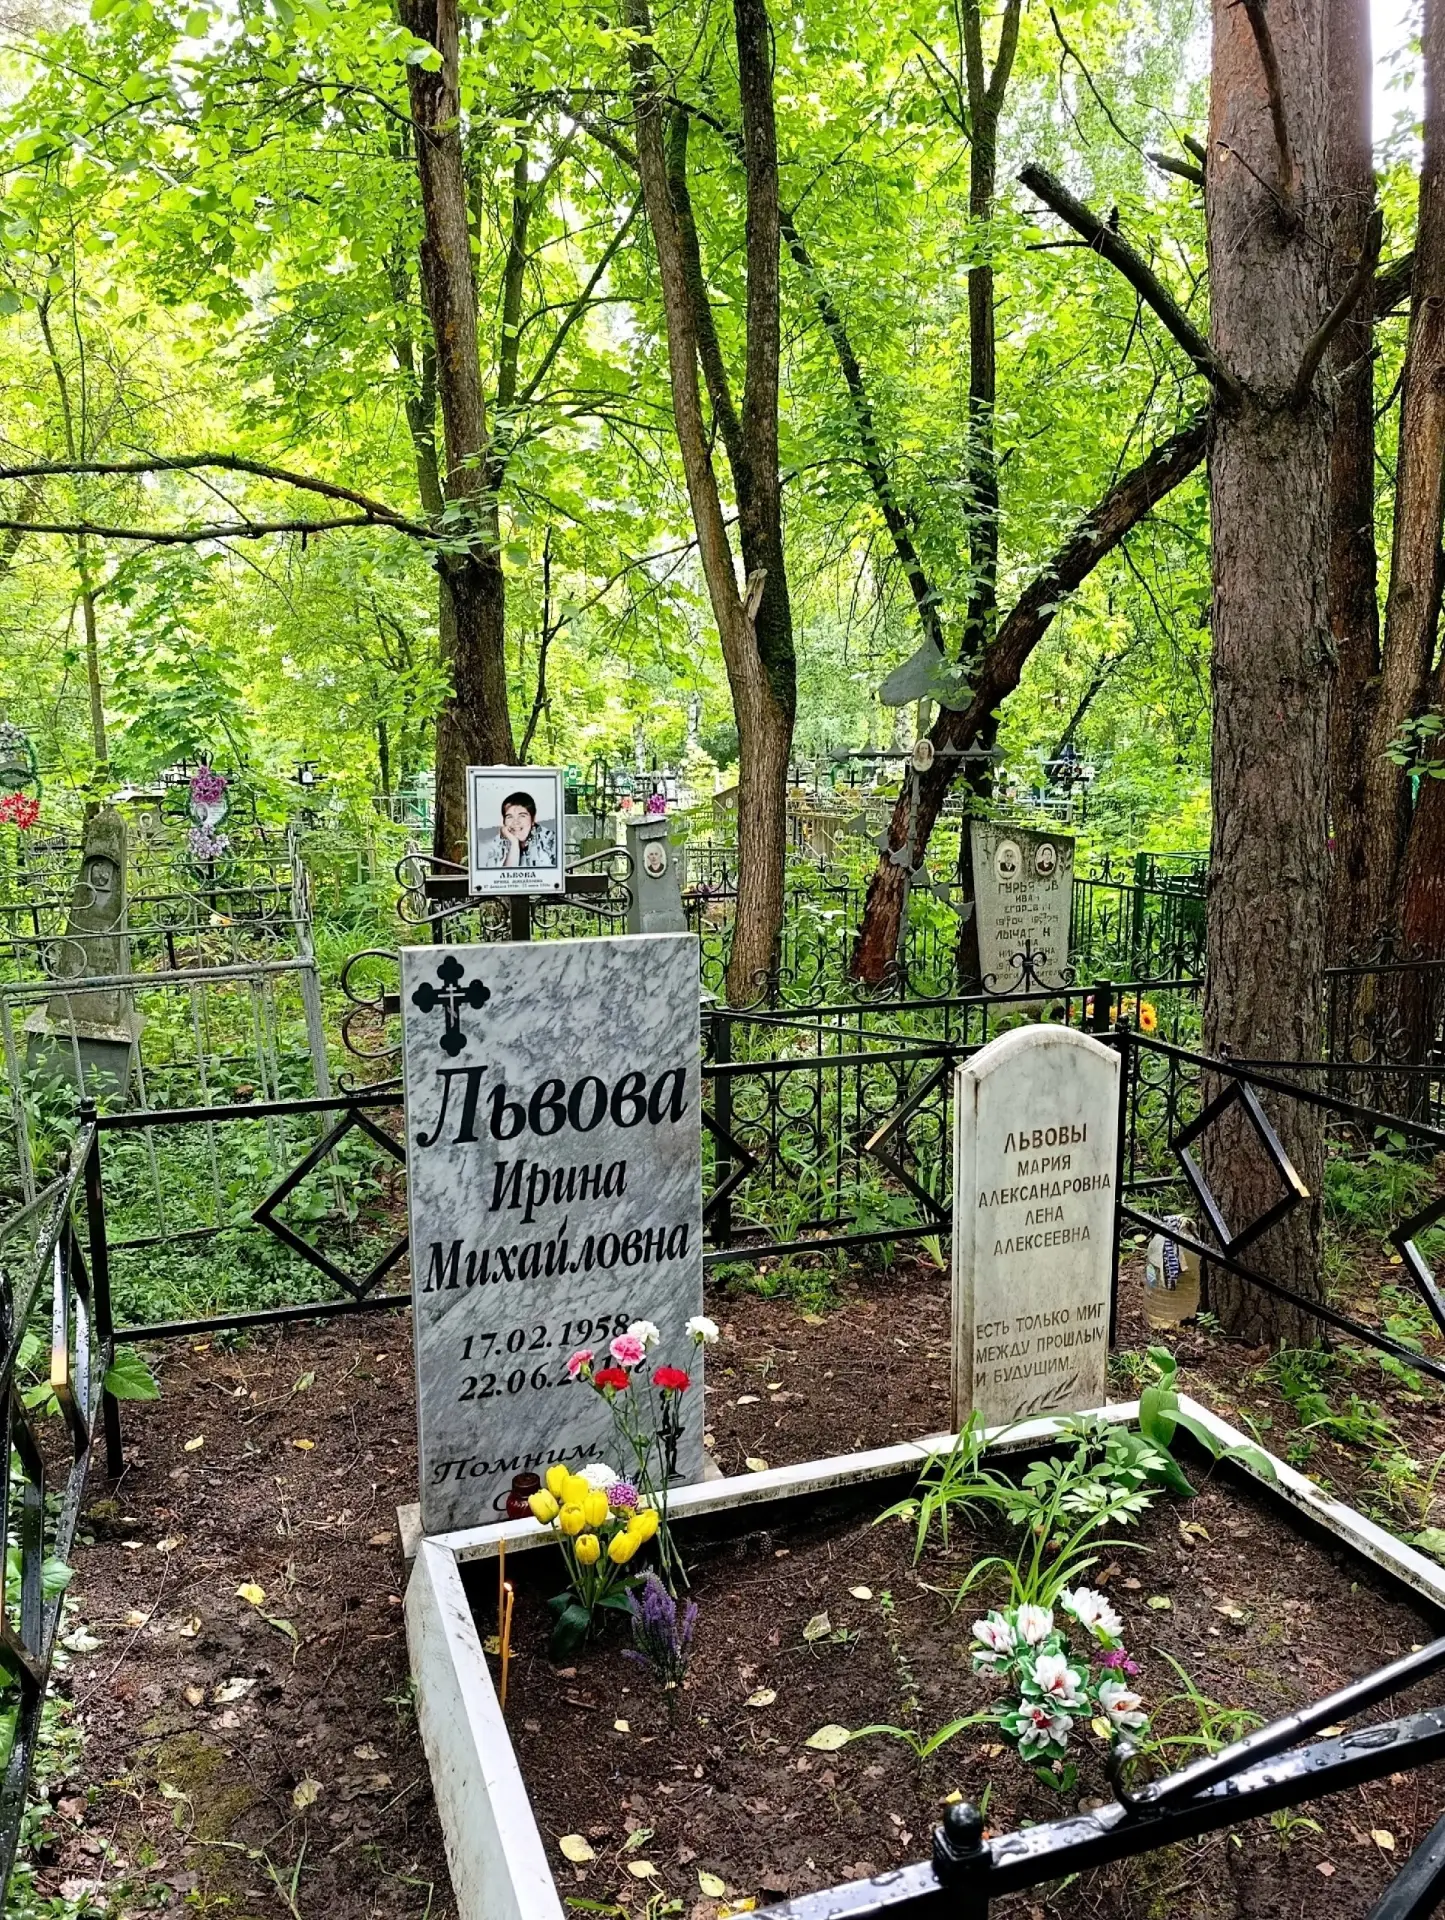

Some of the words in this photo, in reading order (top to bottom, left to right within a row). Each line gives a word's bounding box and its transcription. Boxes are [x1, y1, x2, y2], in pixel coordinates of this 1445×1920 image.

[416, 1066, 688, 1148] Львова
[1003, 1123, 1088, 1154] ЛЬВОВЫ
[1017, 1154, 1071, 1178] МАРИЯ
[488, 1159, 628, 1225] Ирина
[978, 1173, 1111, 1209] АЛЕКСАНДРОВНА
[1024, 1205, 1065, 1226] ЛЕНА
[993, 1225, 1091, 1257] АЛЕКСЕЕВНА
[459, 1313, 644, 1361] 17.02.1958
[976, 1320, 1010, 1340] ЕСТЬ
[1015, 1309, 1070, 1333] ТОЛЬКО
[1076, 1302, 1106, 1321] МИГ
[976, 1339, 1031, 1364] МЕЖДУ
[976, 1371, 987, 1388] И
[431, 1442, 605, 1486] Помним,
